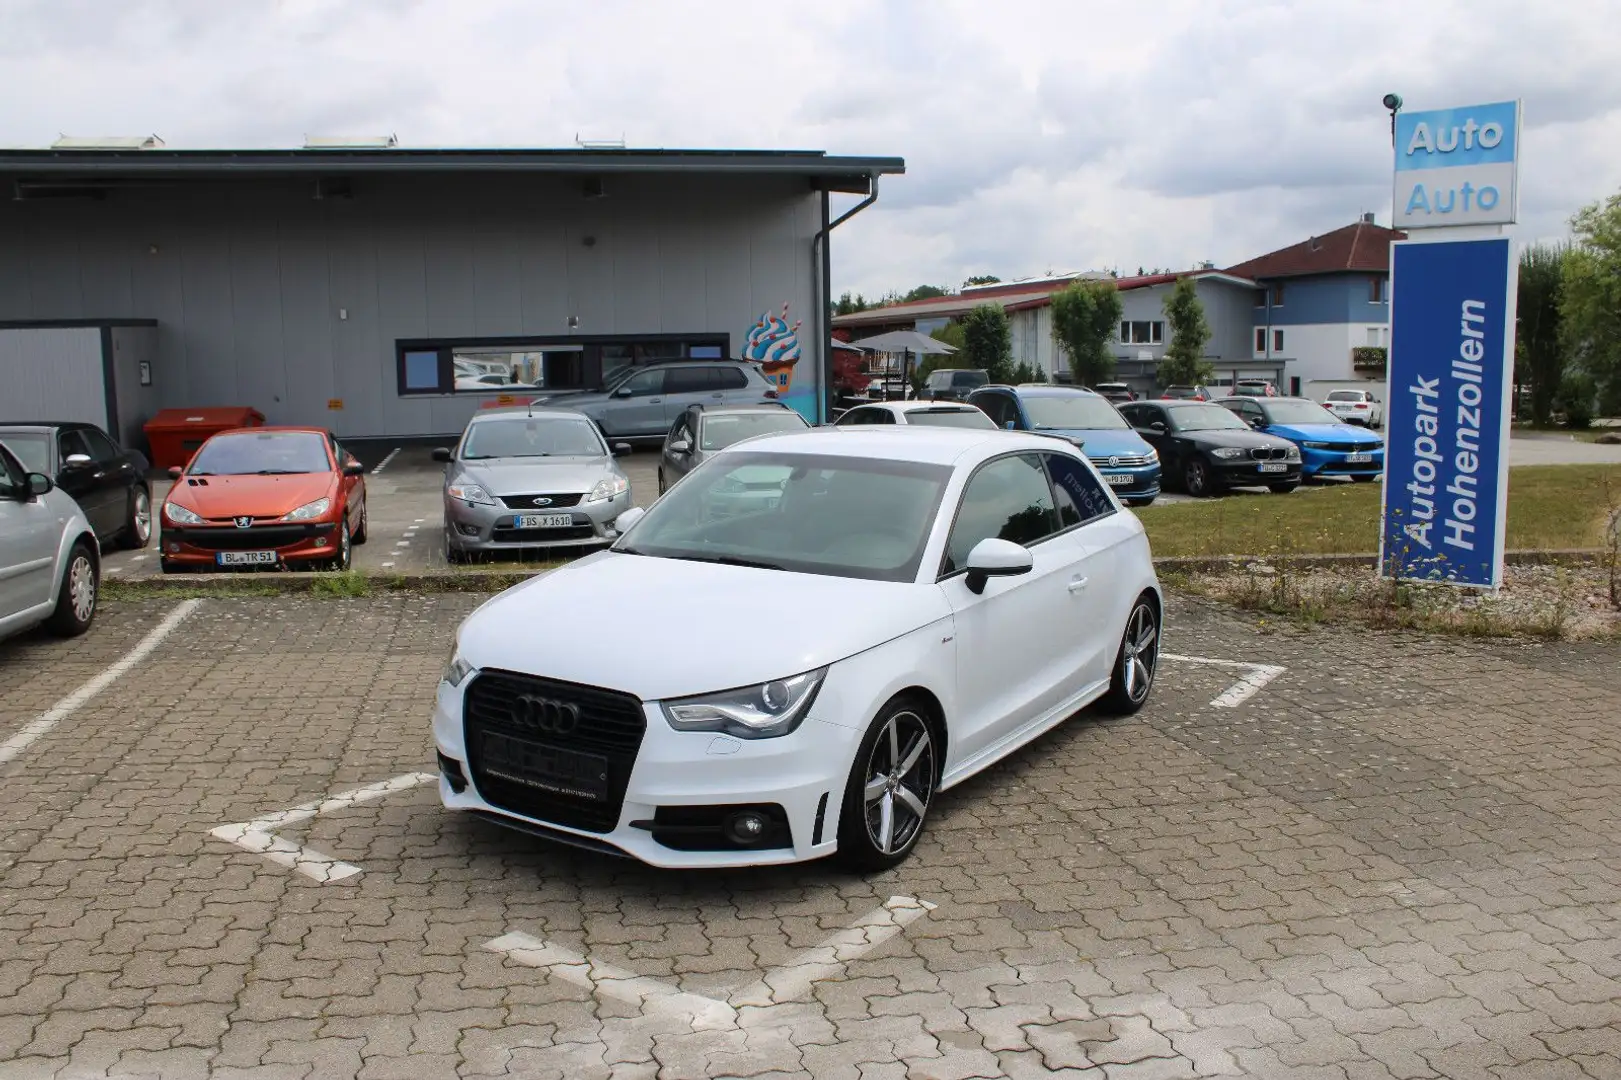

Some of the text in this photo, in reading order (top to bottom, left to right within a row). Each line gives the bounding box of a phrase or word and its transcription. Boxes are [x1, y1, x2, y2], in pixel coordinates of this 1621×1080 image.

[1406, 118, 1504, 156] Auto
[1405, 182, 1500, 215] Auto
[1444, 299, 1486, 551] Hohenzollern
[1403, 374, 1443, 550] Autopark
[225, 553, 240, 563] BL
